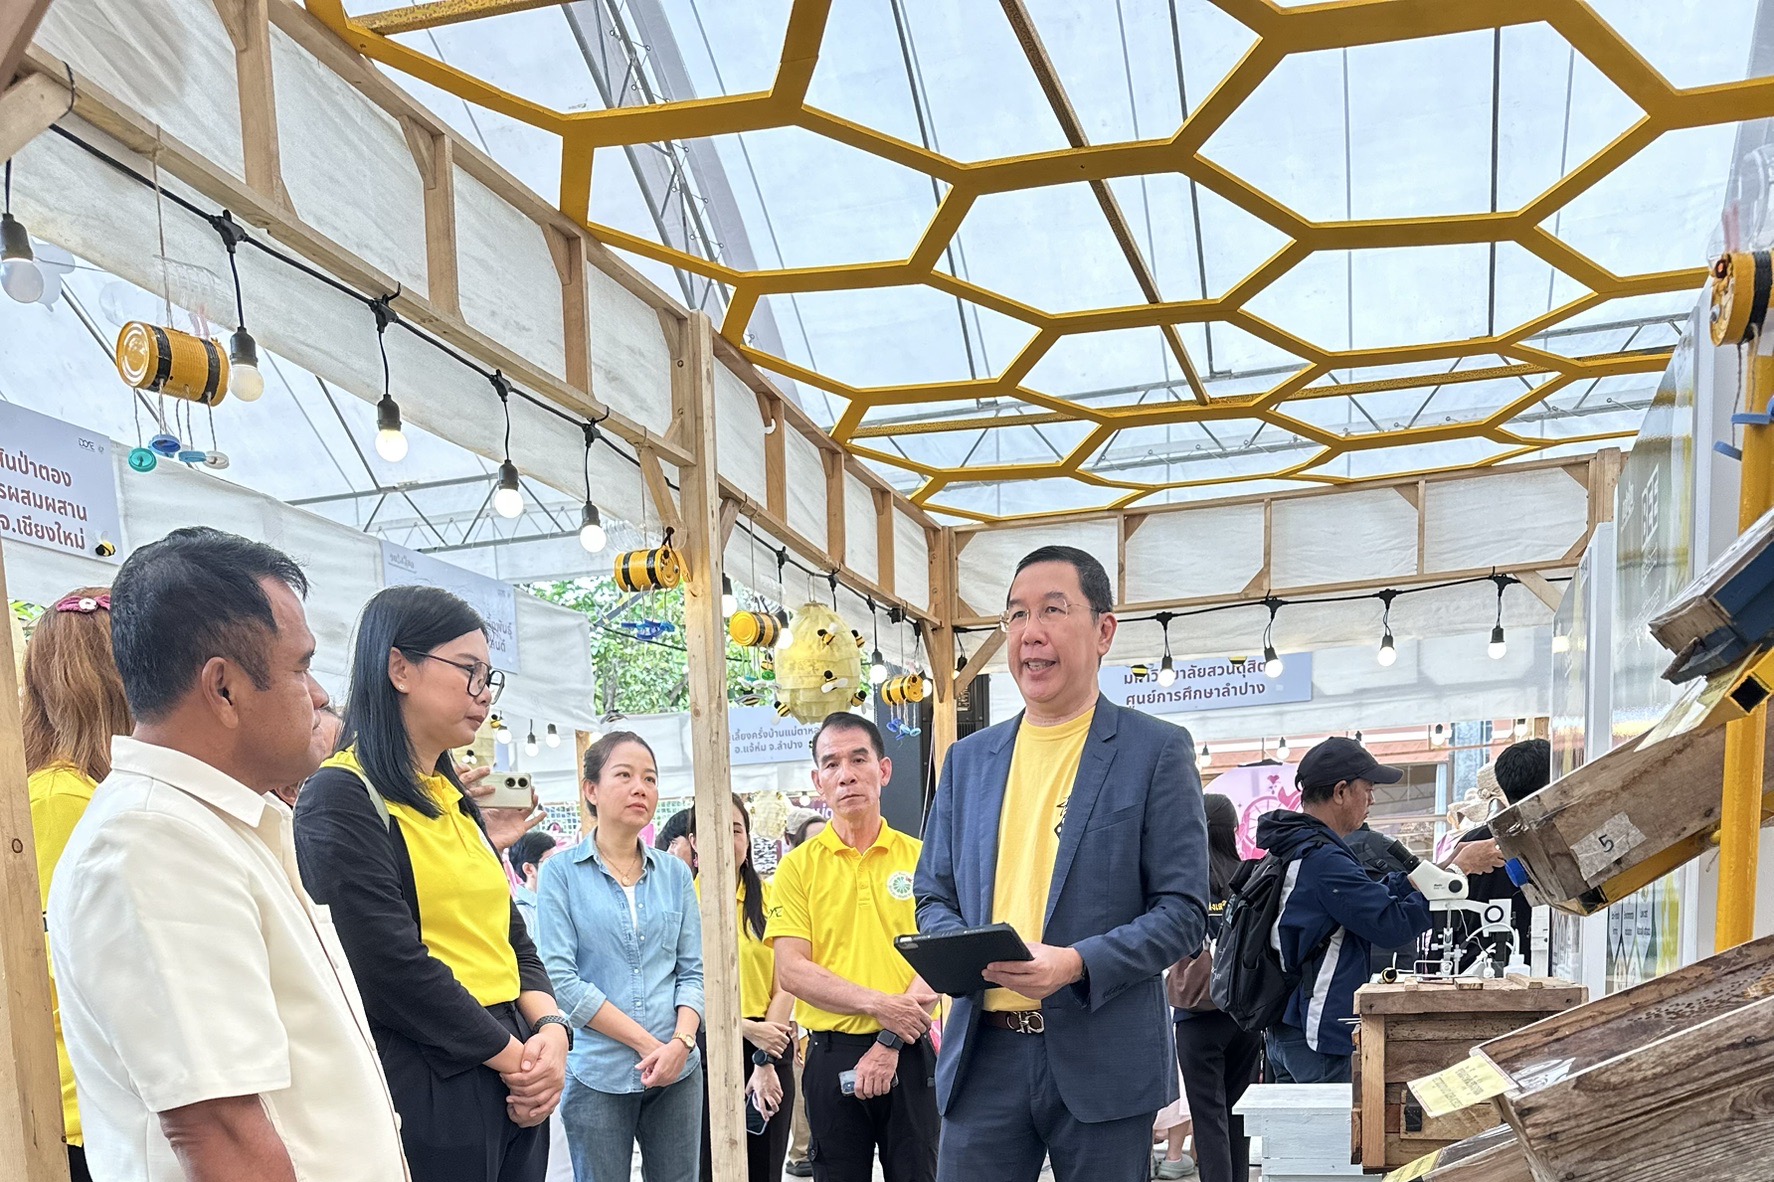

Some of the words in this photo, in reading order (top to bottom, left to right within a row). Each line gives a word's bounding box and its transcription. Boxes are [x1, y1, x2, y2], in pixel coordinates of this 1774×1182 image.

[1124, 659, 1267, 685] มาวิาลัยสวนดุสิต
[1126, 682, 1266, 709] ศูนย์การศึกษาลำปาง
[1598, 833, 1615, 853] 5
